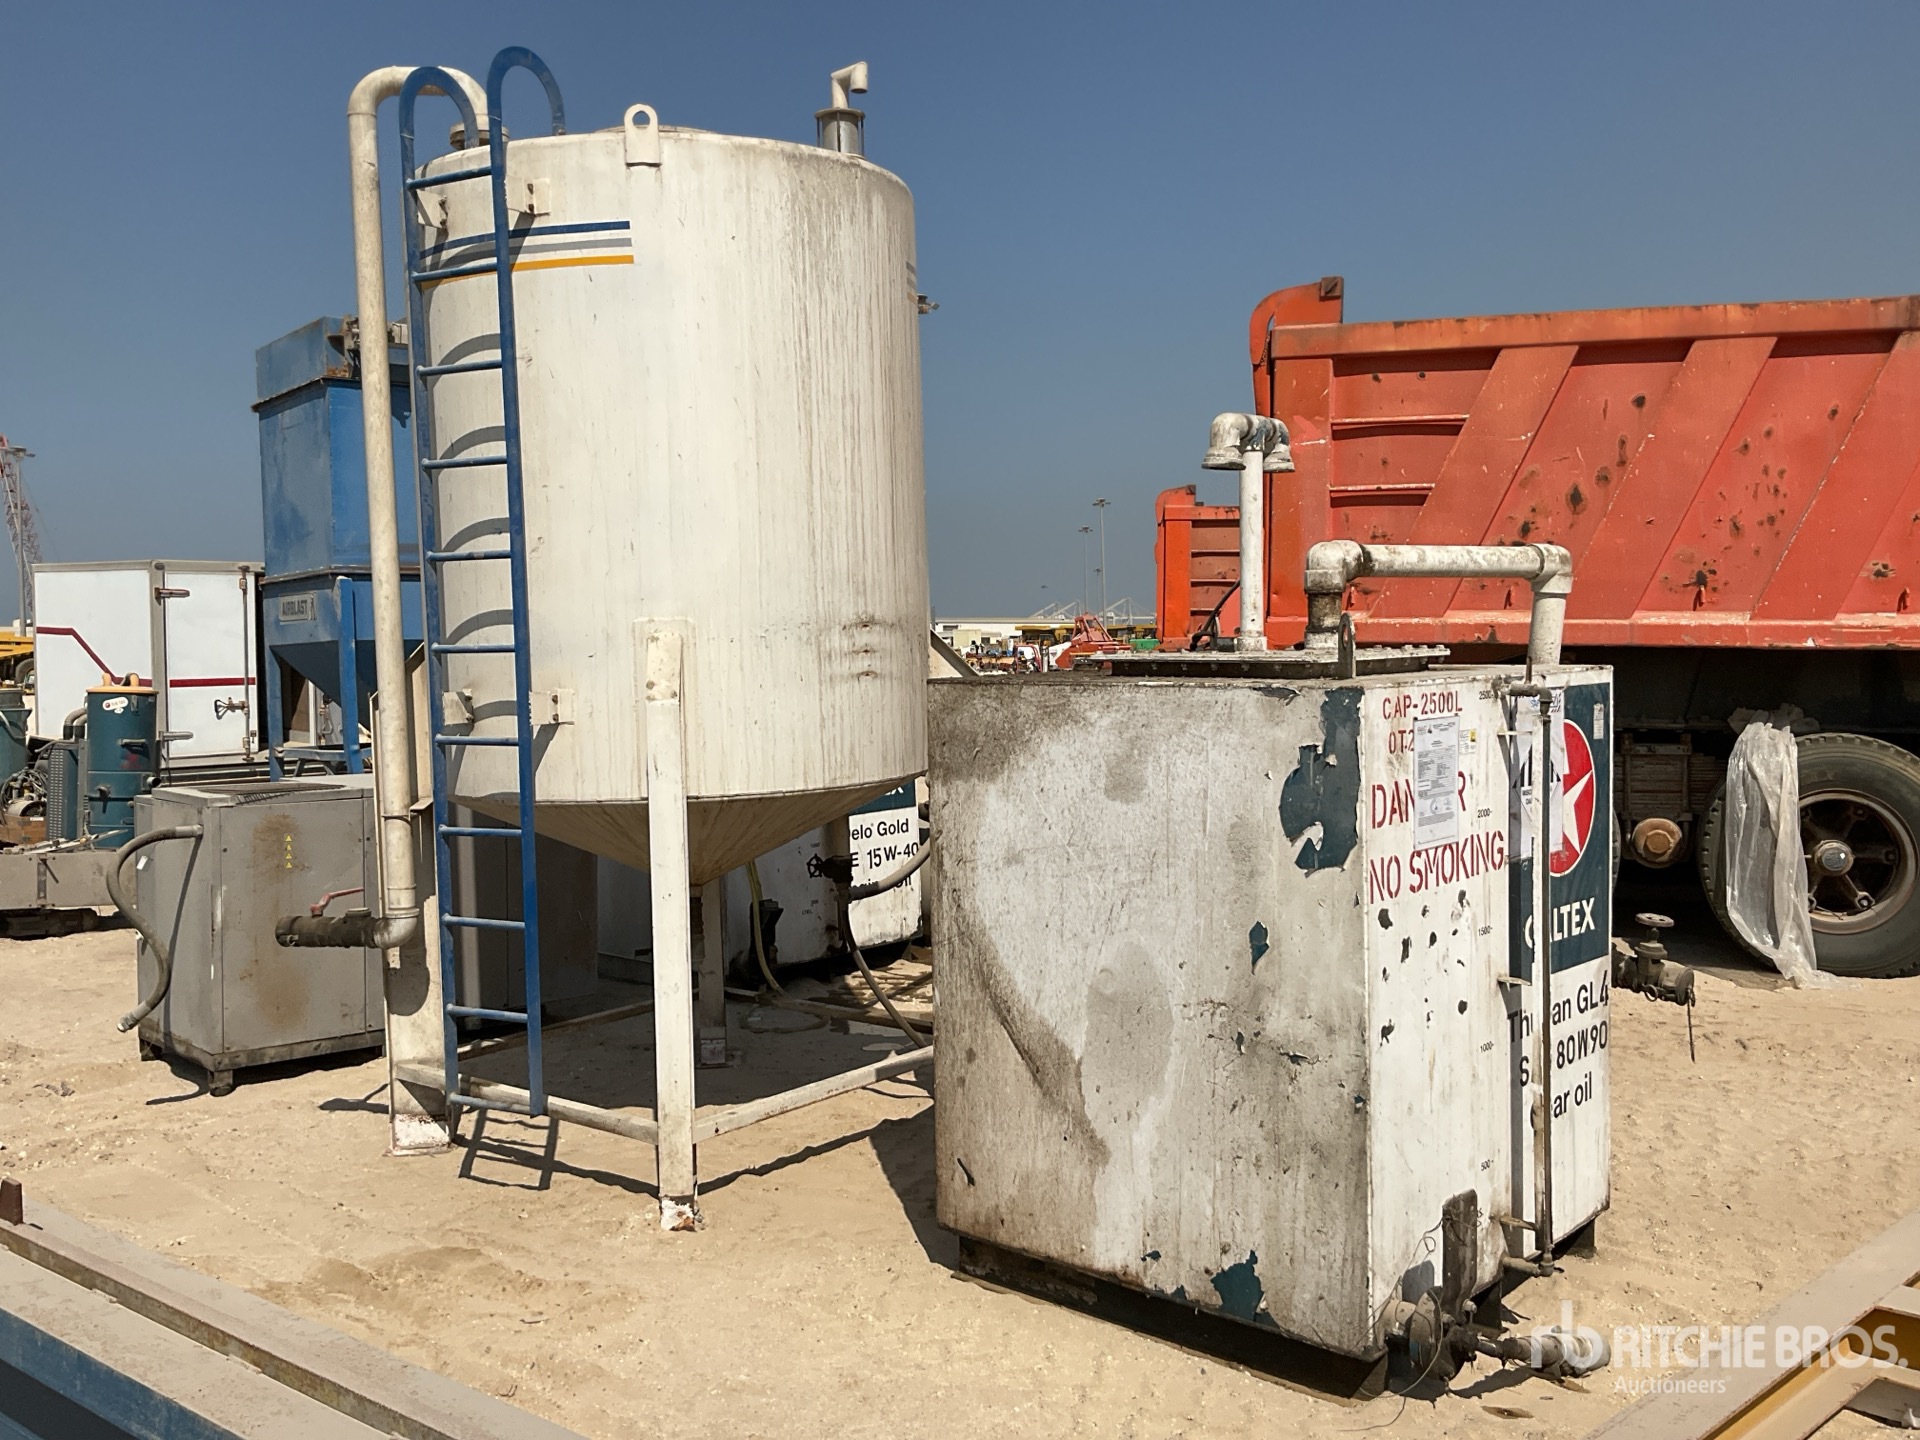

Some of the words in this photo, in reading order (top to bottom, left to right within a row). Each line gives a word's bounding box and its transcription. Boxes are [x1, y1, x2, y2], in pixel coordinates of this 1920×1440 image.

[1383, 690, 1463, 720] CAP-2500L
[1372, 770, 1466, 829] DANR
[850, 825, 873, 840] elo
[877, 818, 909, 836] Gold
[1369, 855, 1402, 905] NO
[1409, 830, 1504, 893] SMOKING
[1525, 897, 1595, 949] CLTEX
[1507, 998, 1571, 1042] Than
[1556, 1020, 1608, 1069] 80W90
[1574, 1071, 1592, 1106] oil
